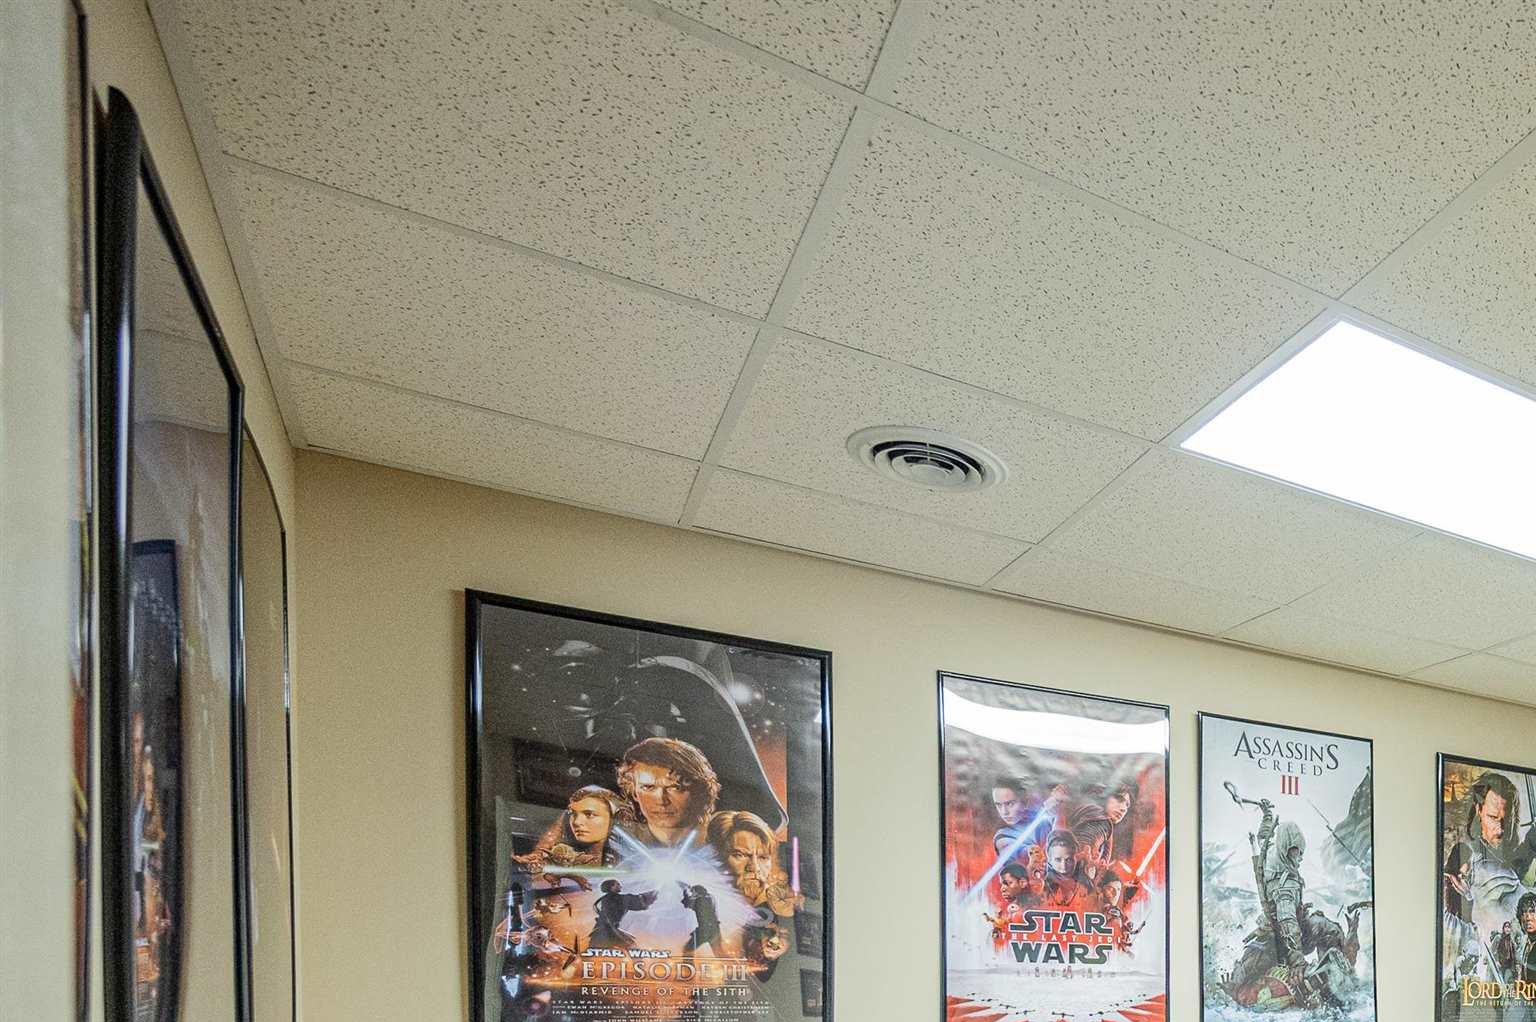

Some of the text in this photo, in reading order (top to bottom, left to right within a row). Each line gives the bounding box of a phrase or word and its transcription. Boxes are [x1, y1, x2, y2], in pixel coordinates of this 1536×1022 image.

[1257, 757, 1323, 777] CREED
[1009, 909, 1115, 935] STAR
[1041, 934, 1077, 942] LAST
[581, 948, 672, 959] STAR WARS
[1010, 941, 1114, 966] WARS
[581, 960, 716, 982] EPISODE
[581, 986, 748, 997] REVENGE OF THE SITH
[1462, 975, 1503, 1007] LORD
